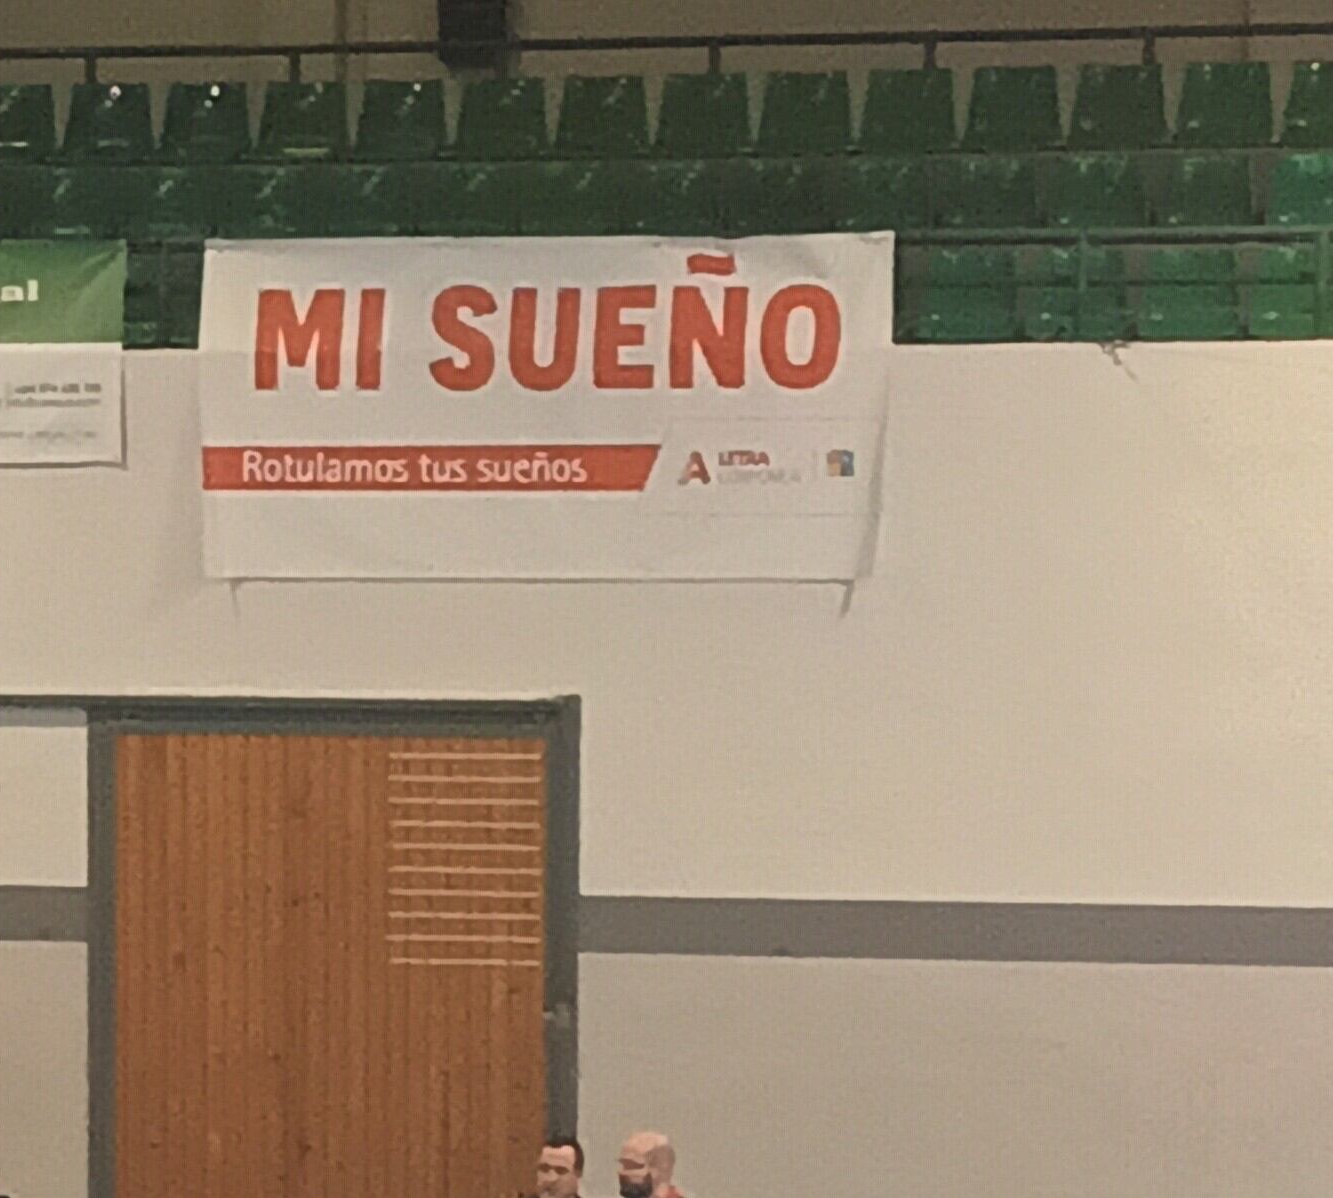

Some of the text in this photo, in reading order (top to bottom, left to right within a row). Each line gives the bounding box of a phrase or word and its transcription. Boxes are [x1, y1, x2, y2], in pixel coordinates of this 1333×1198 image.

[254, 253, 842, 391] MI SUEÑO
[242, 450, 589, 485] Rotulamos tus sueños
